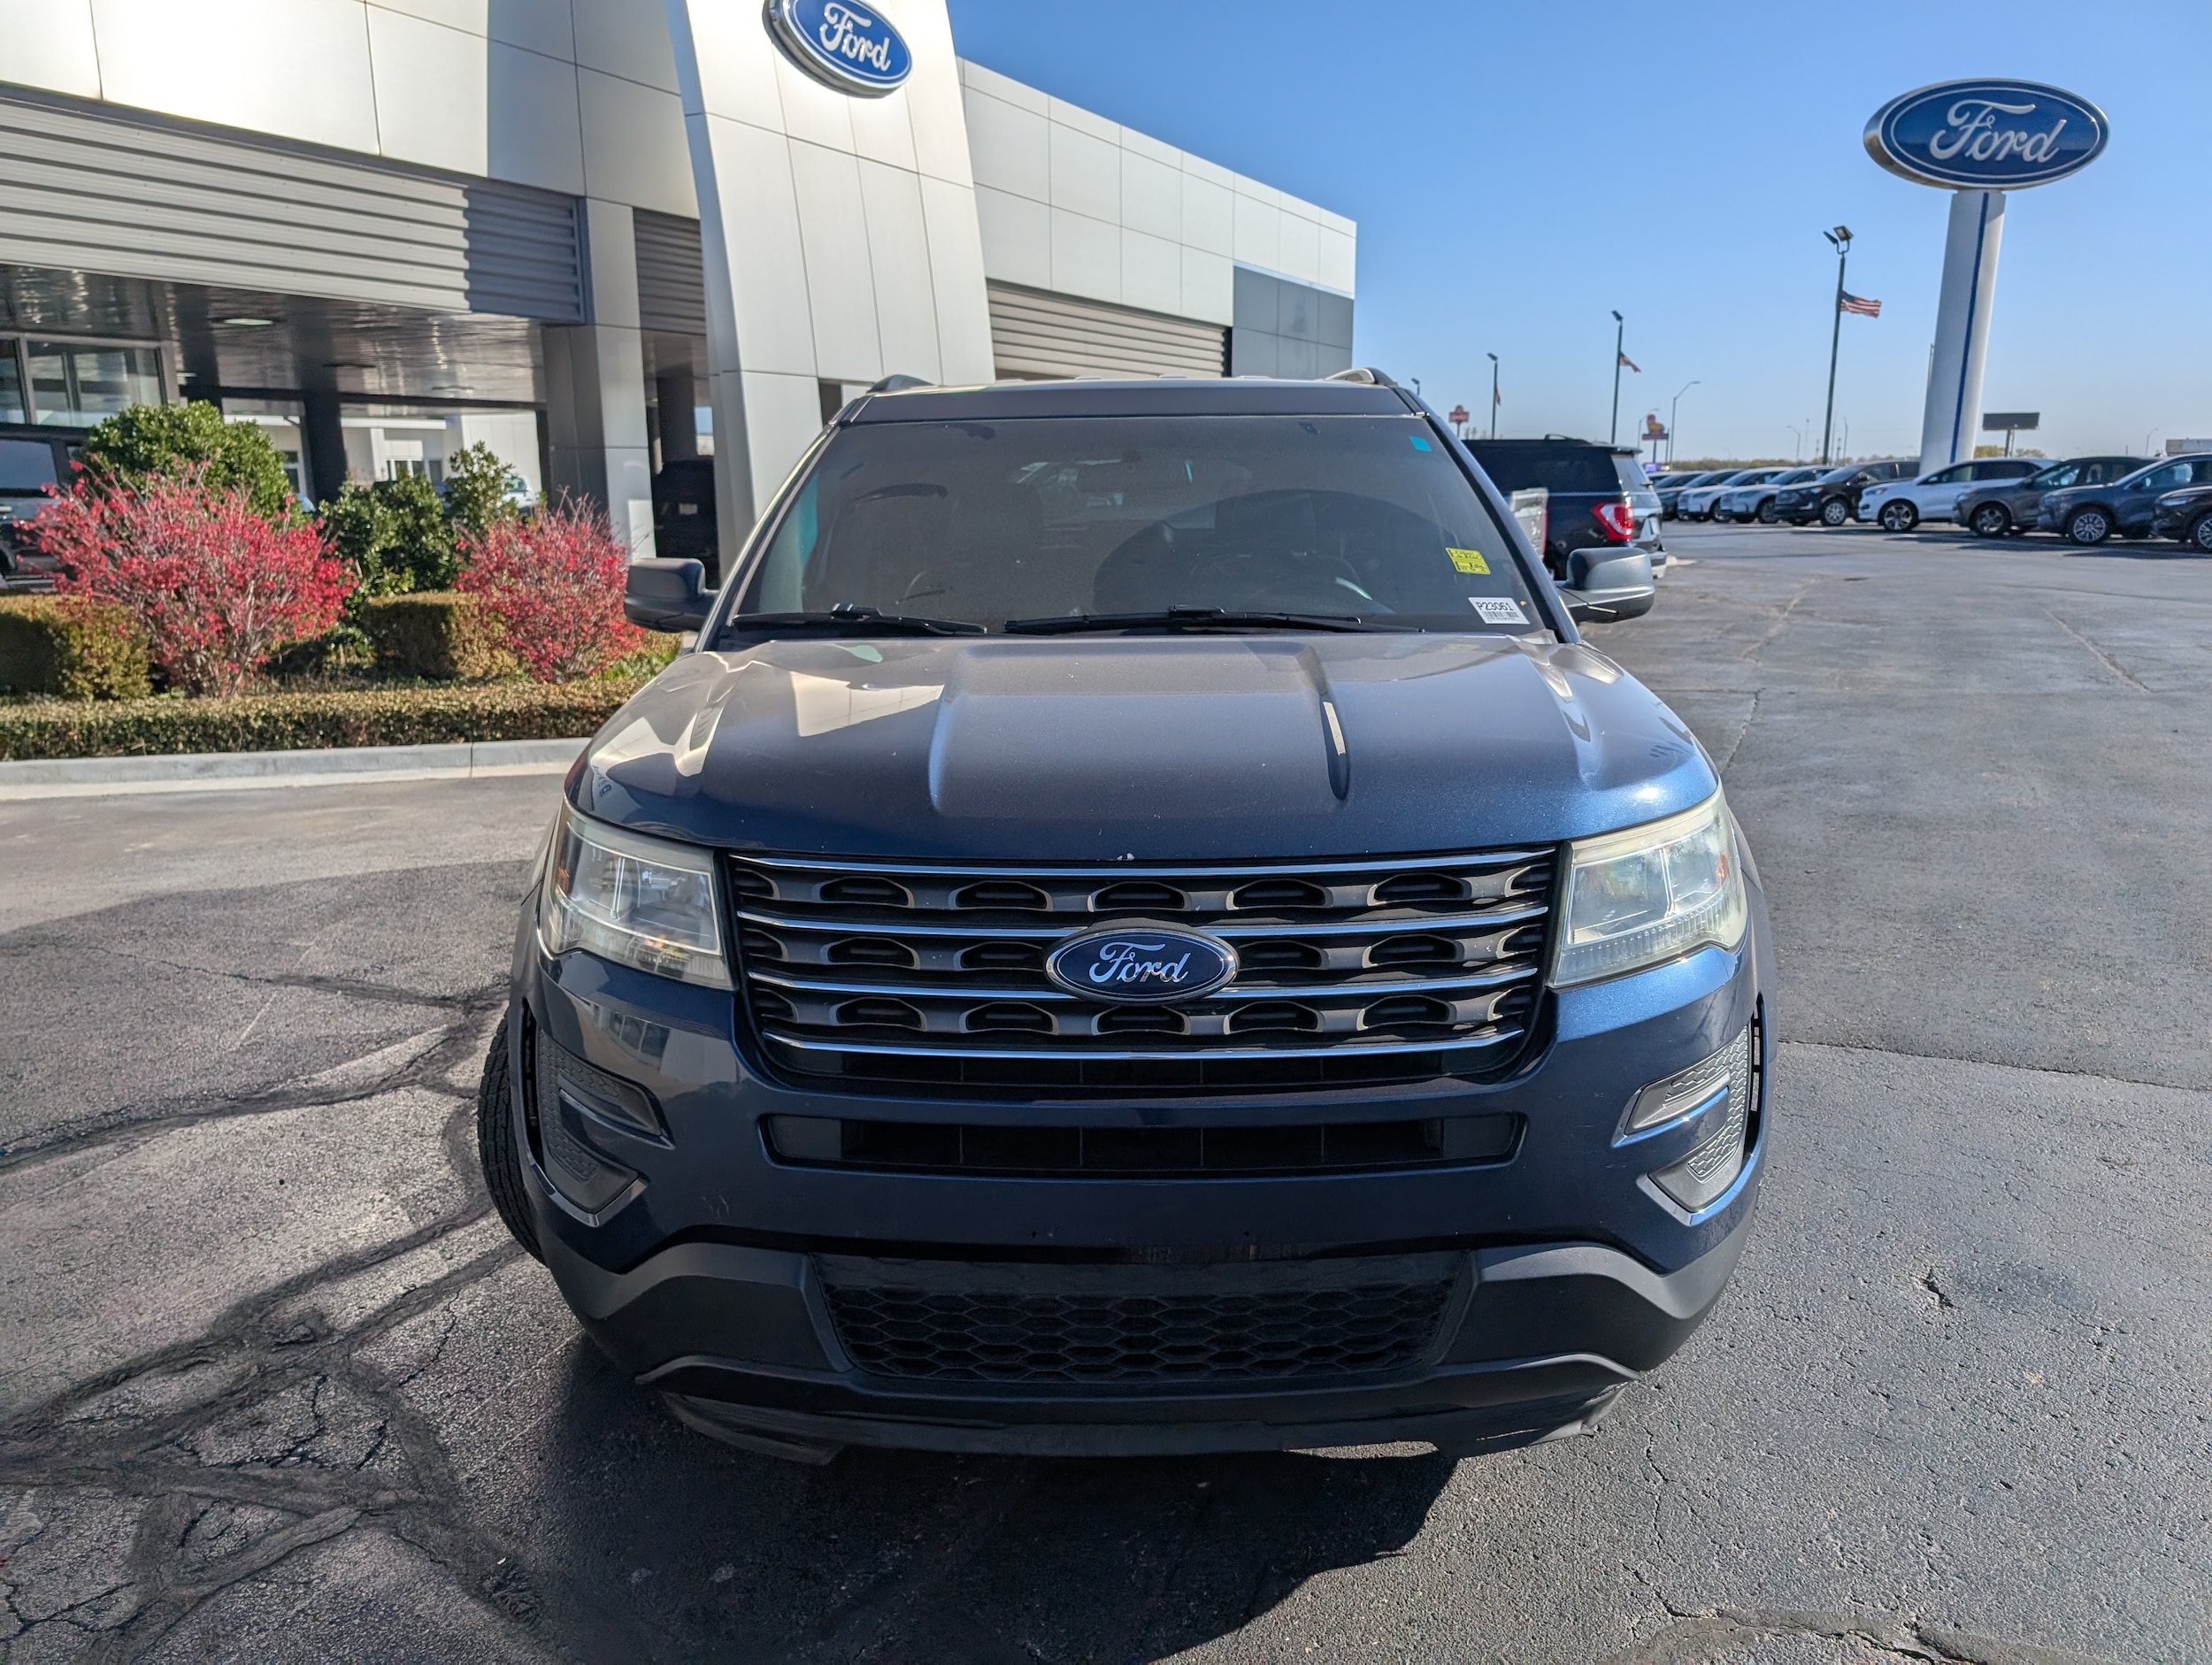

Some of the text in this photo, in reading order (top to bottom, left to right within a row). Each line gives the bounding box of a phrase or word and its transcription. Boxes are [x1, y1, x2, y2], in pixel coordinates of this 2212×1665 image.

[819, 3, 891, 72] Ford
[1930, 99, 2067, 163] Ford
[1475, 602, 1514, 611] P23061
[1089, 941, 1191, 983] Ford
